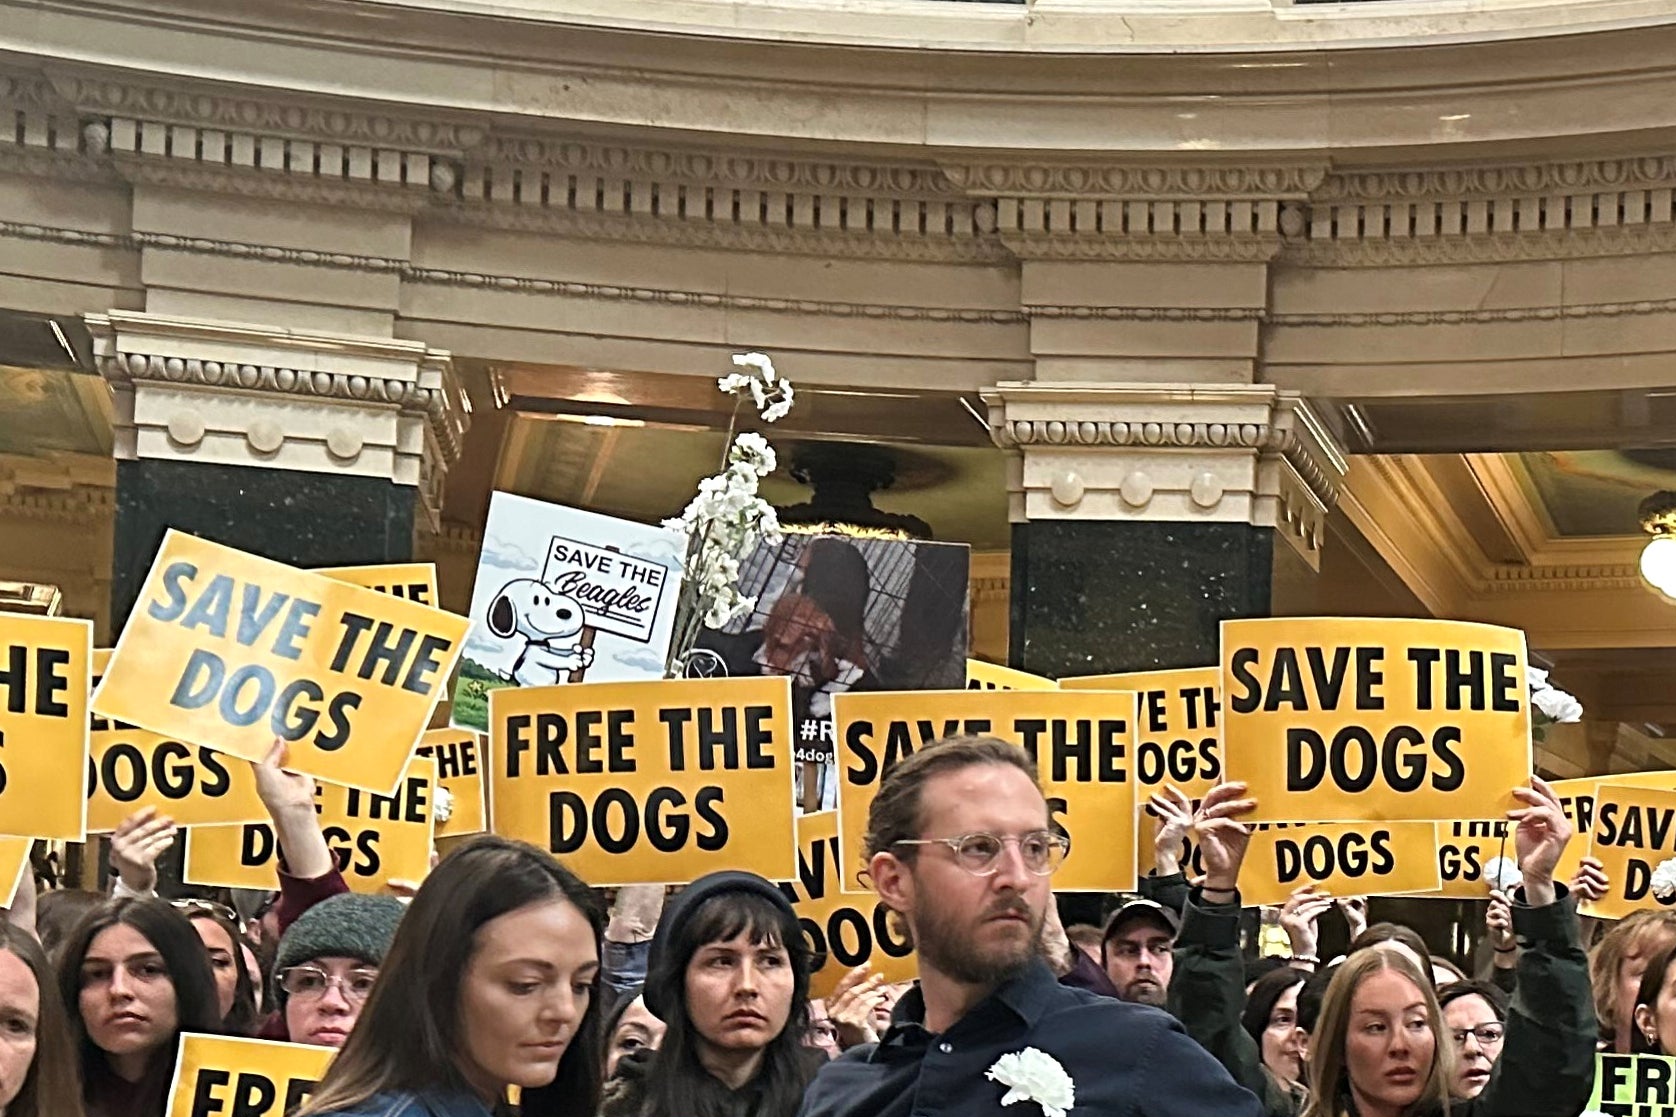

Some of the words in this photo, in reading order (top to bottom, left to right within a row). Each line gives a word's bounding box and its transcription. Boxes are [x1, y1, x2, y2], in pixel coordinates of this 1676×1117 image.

[554, 544, 613, 574] SAVE
[619, 561, 661, 587] THE
[554, 571, 653, 616] Beagles
[148, 562, 322, 659] SAVE
[330, 610, 451, 695] THE
[170, 648, 363, 752] DOGS
[1230, 646, 1385, 714] SAVE
[1407, 648, 1520, 713] THE
[88, 741, 230, 802] OGS
[505, 709, 636, 778] FREE
[658, 705, 775, 772] THE
[1014, 719, 1127, 782] THE
[1286, 725, 1465, 793] DOGS
[242, 823, 380, 877] DGS
[549, 786, 730, 855] DOGS
[1275, 830, 1394, 884] DOGS
